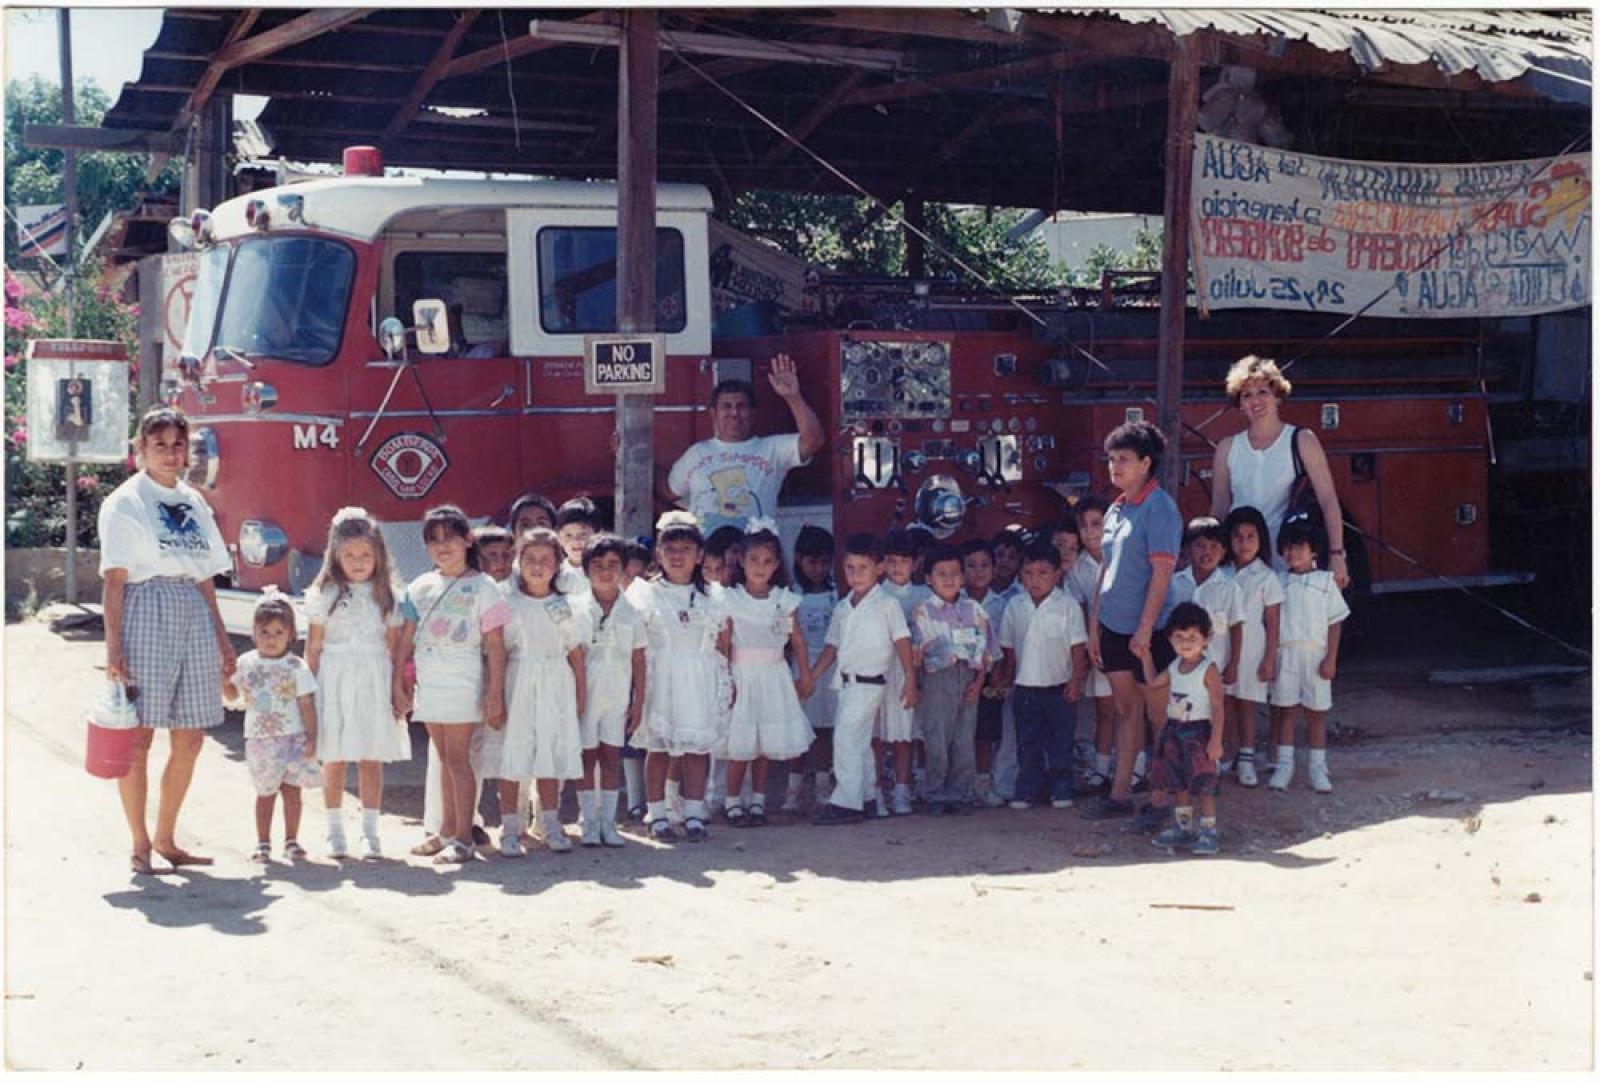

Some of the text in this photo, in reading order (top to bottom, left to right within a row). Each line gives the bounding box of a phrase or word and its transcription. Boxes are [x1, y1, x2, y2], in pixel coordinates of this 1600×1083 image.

[612, 344, 635, 363] NO
[597, 362, 651, 382] PARKING
[293, 424, 340, 449] M4
